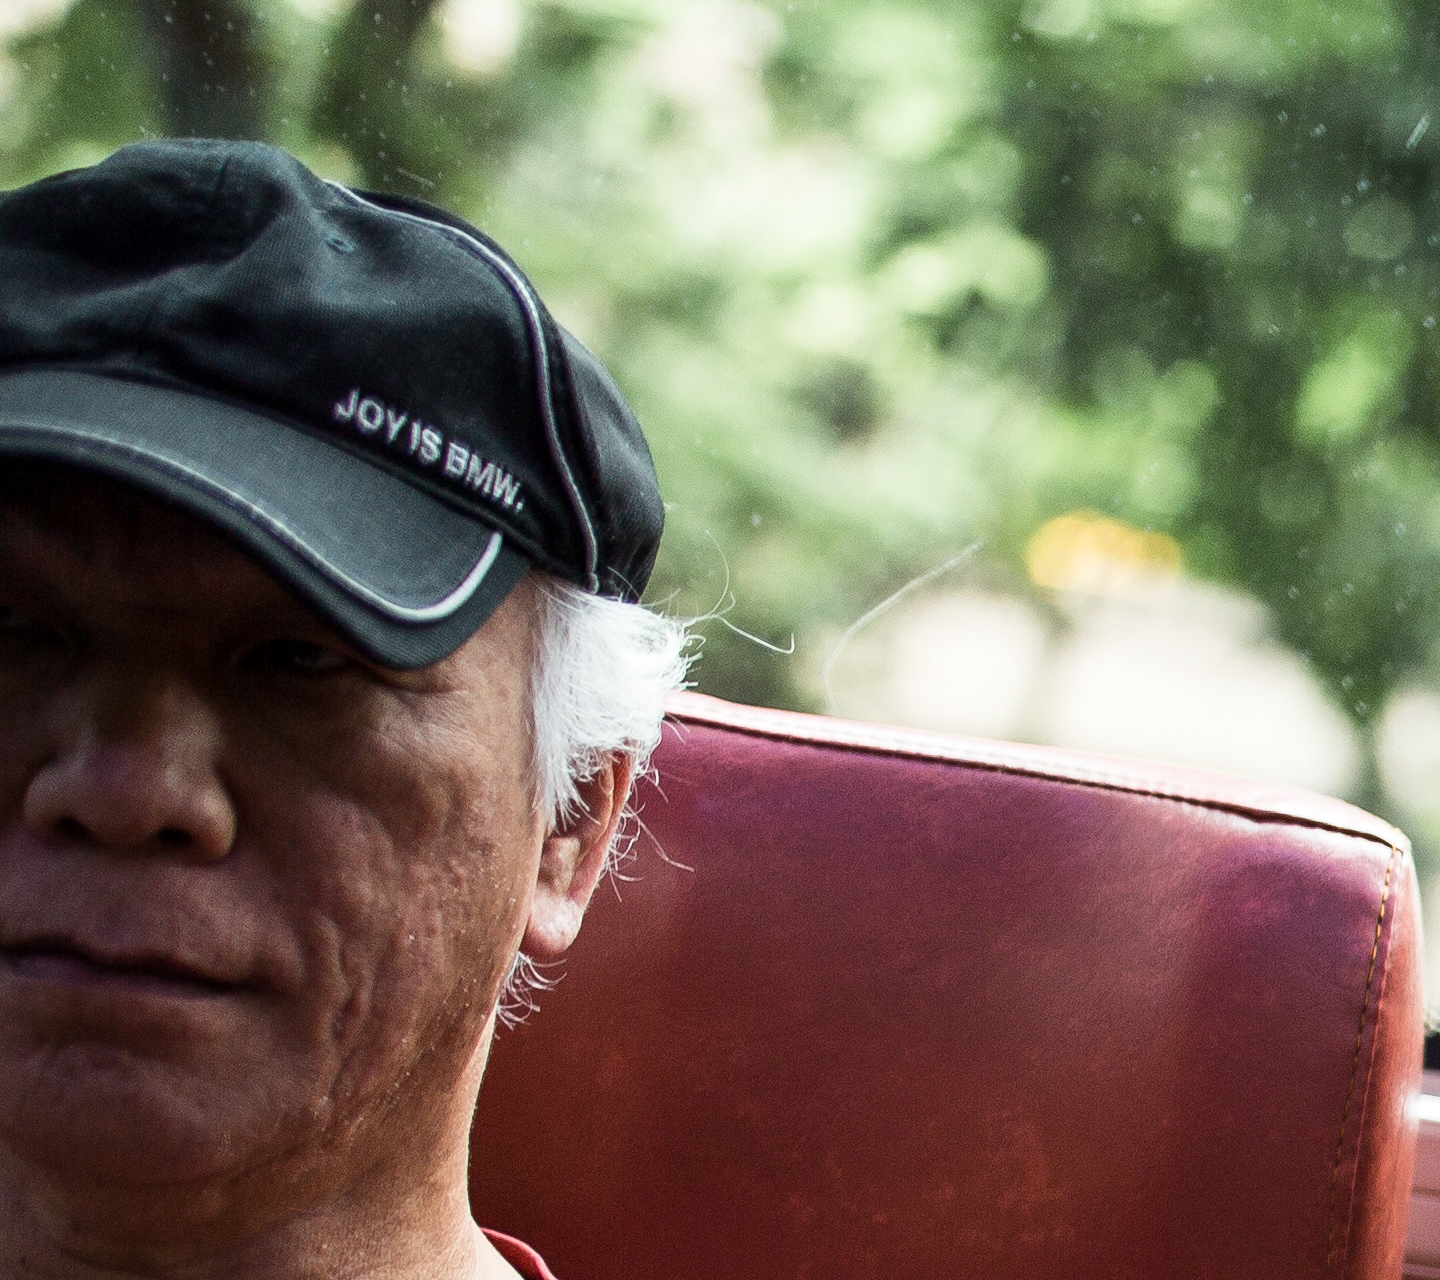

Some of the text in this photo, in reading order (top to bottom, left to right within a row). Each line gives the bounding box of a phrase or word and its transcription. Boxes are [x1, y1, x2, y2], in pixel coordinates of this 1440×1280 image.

[334, 386, 524, 512] JOY IS BMW.
